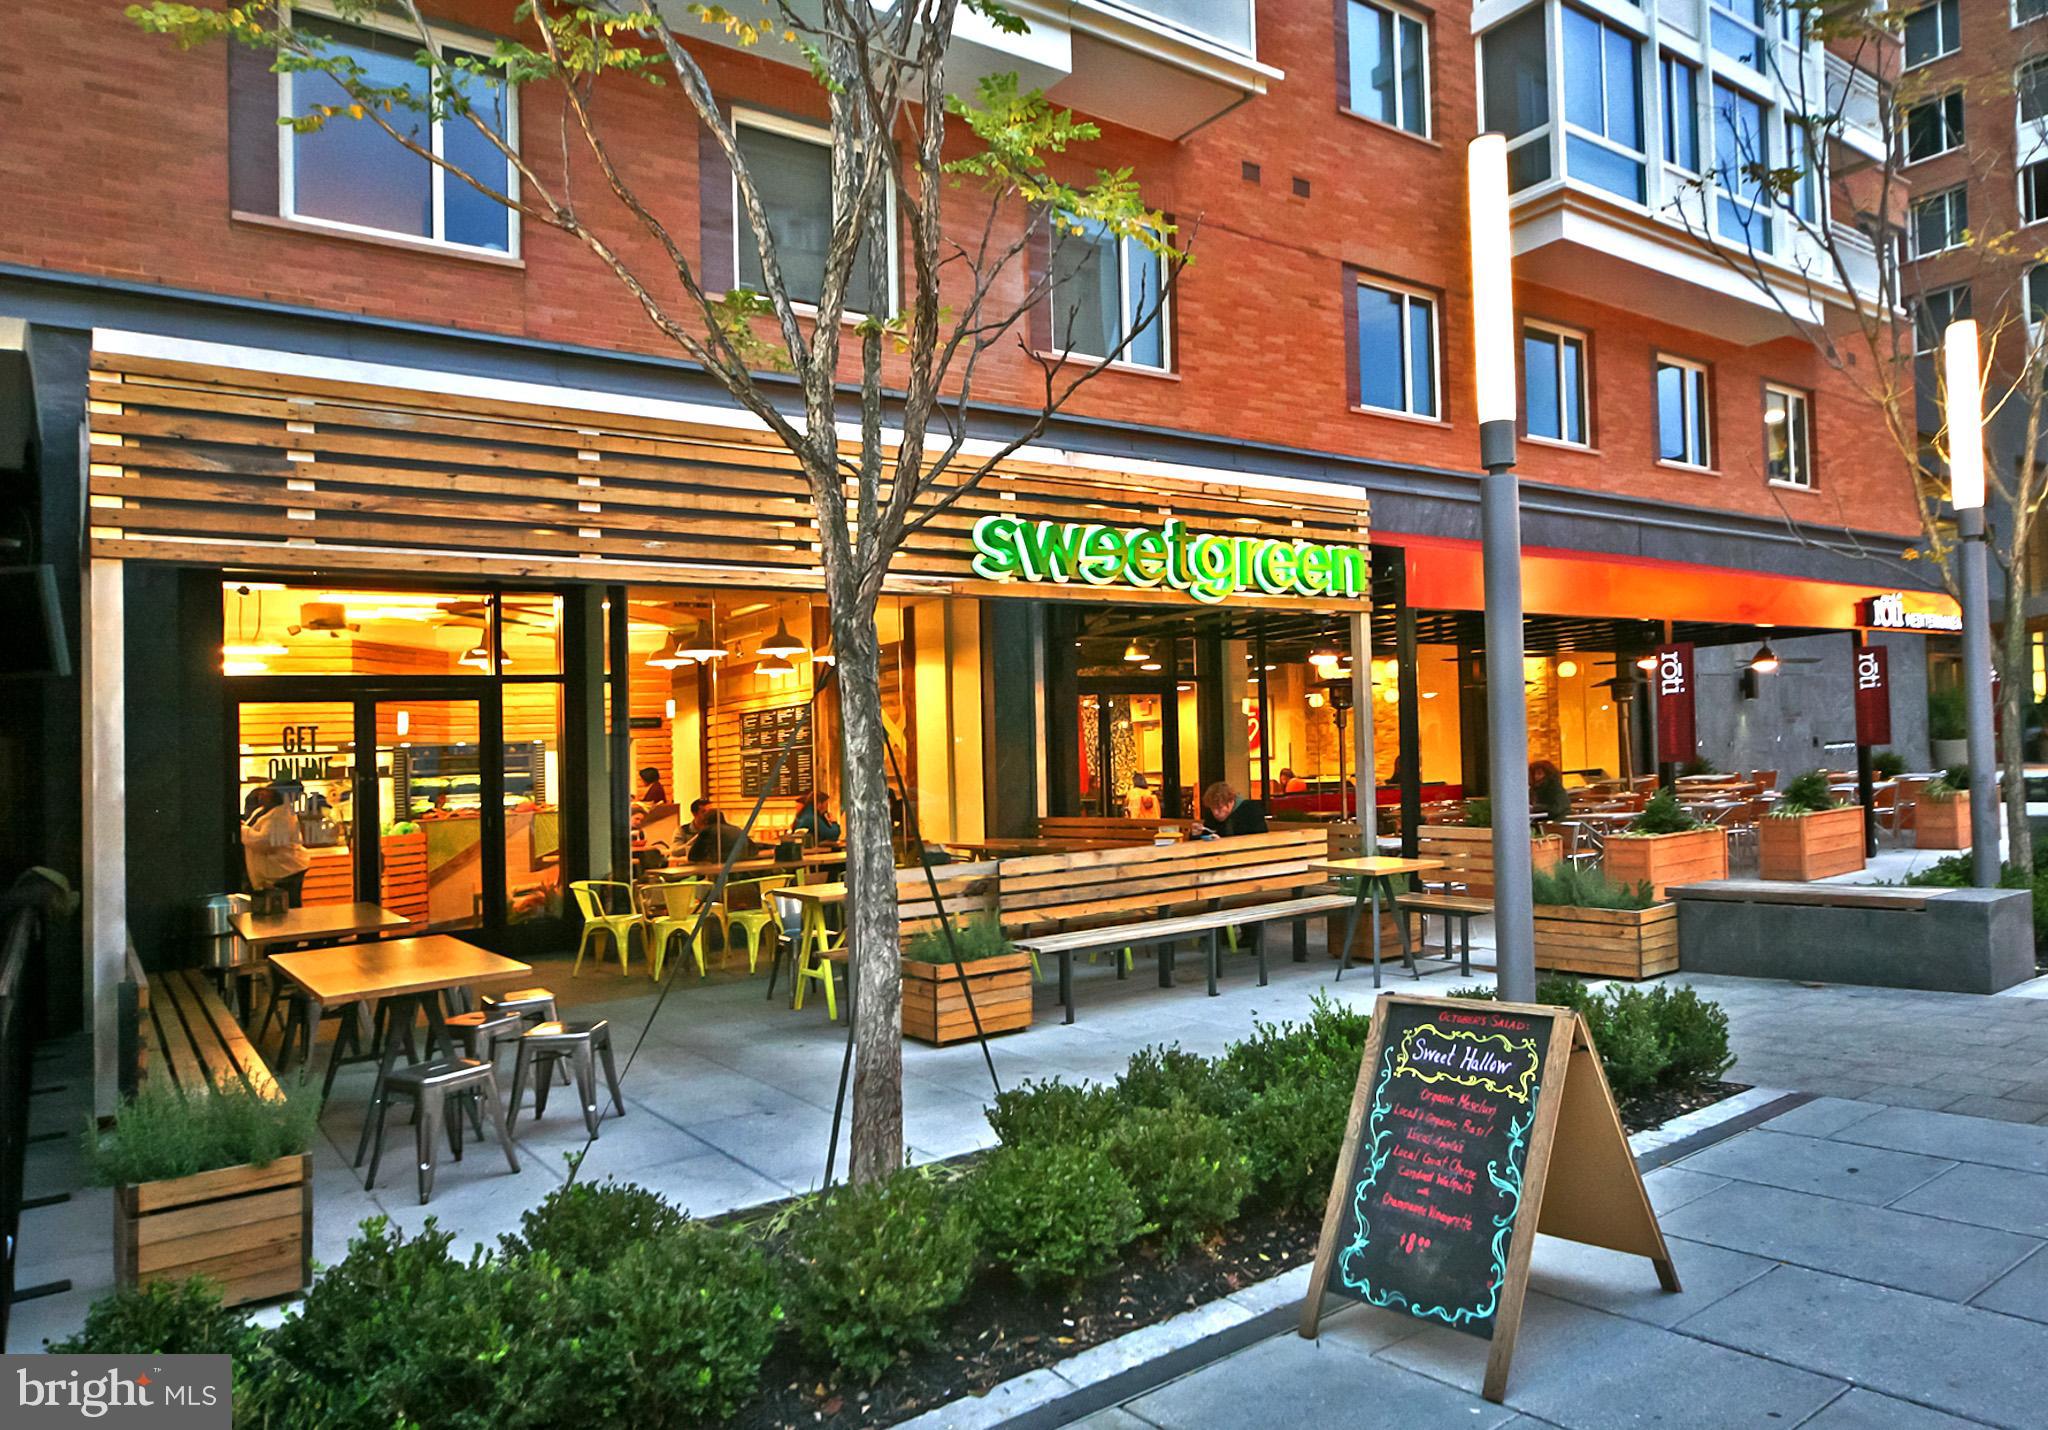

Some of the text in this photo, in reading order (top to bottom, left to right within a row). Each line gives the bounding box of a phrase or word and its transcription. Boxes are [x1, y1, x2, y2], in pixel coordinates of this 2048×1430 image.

[971, 515, 1367, 604] sweetgreen
[282, 726, 319, 753] GET
[1412, 1037, 1512, 1074] Sweet Hallow
[1393, 1103, 1419, 1120] Local
[1392, 1143, 1477, 1180] Local Goat Cheese
